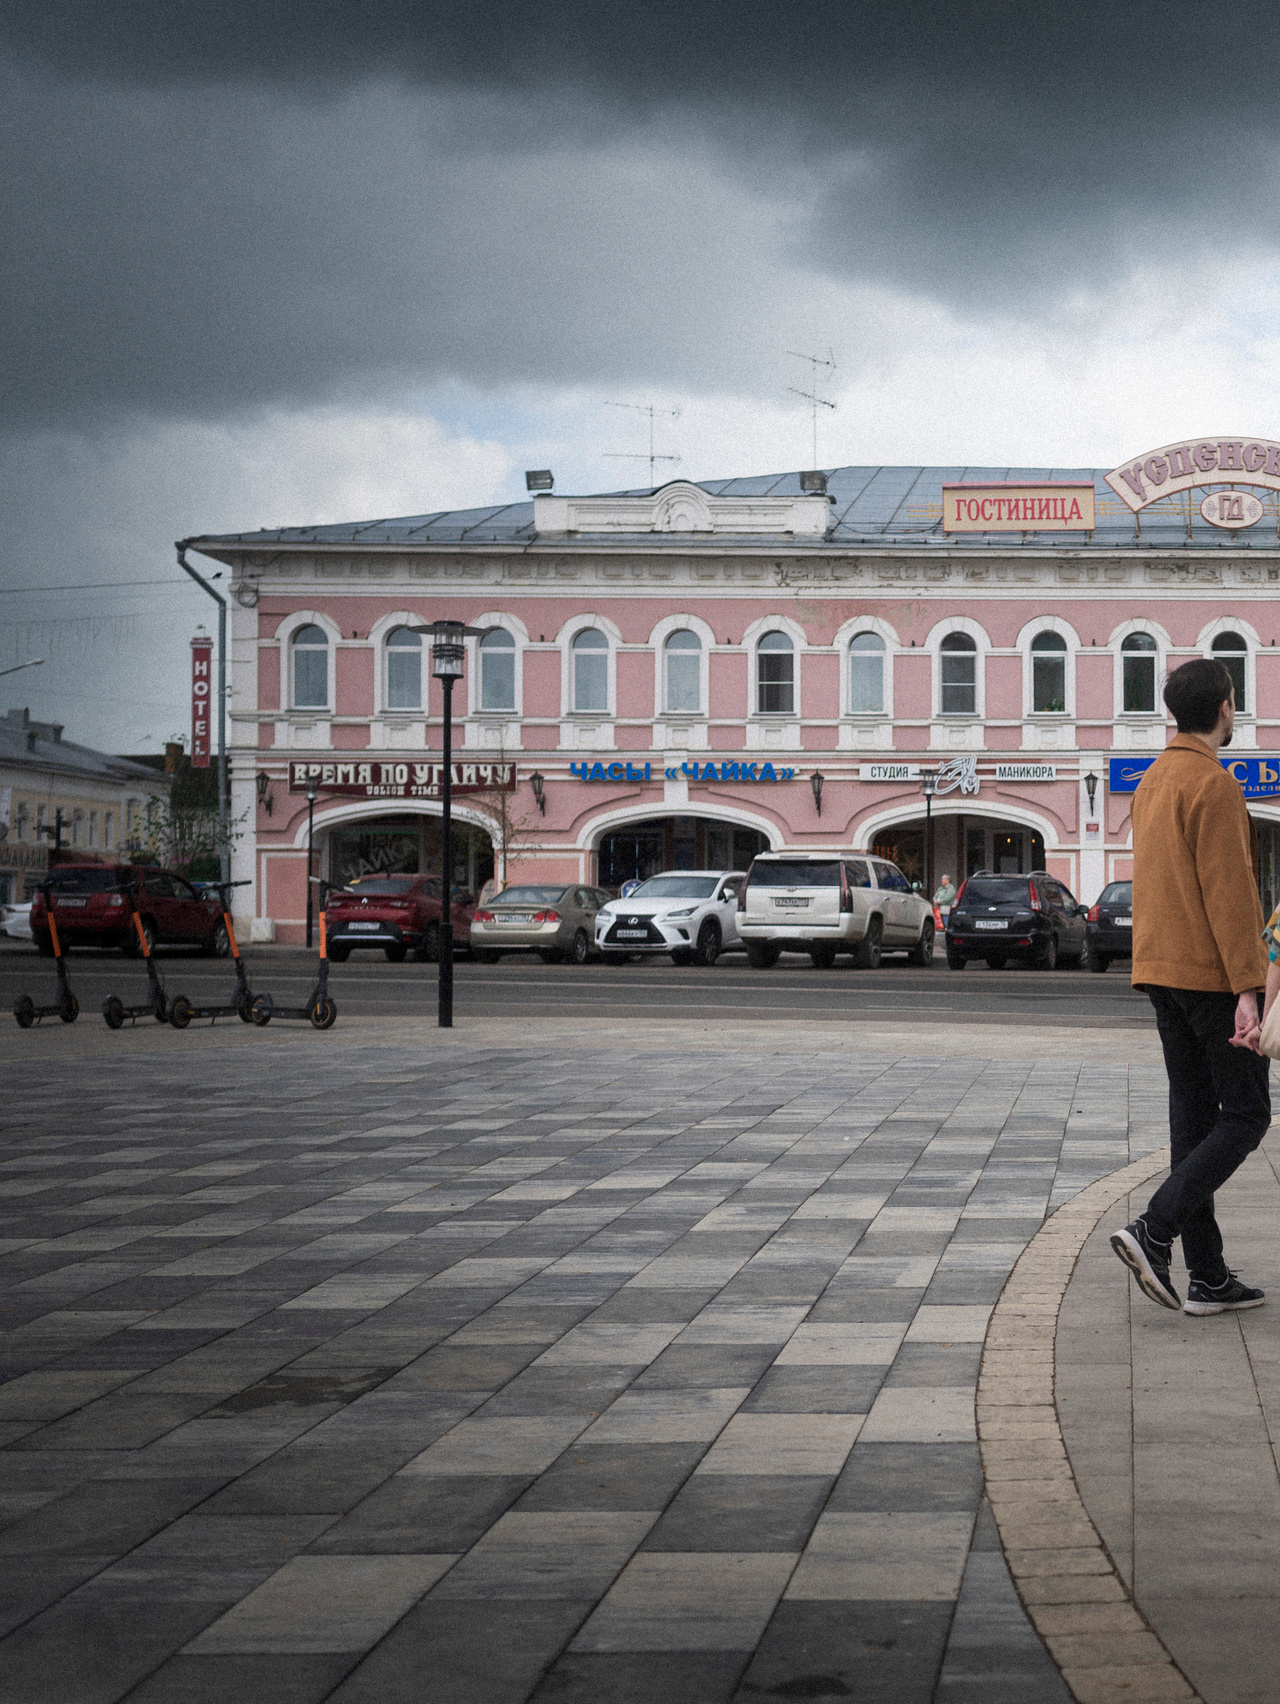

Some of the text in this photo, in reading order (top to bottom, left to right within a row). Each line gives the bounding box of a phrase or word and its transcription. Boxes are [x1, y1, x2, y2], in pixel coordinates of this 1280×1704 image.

[955, 497, 1083, 525] ГОСТИНИЦА
[1219, 495, 1244, 520] ГД
[193, 660, 208, 756] HOTEL
[293, 763, 373, 785] ВРЕМЯ
[381, 763, 408, 785] ПО
[570, 759, 794, 781] ЧАСЫ «ЧАЙКА»
[871, 766, 908, 778] СТУДИЯ
[998, 766, 1053, 778] МАНИКЮРА
[366, 785, 439, 795] UGLICH TIME
